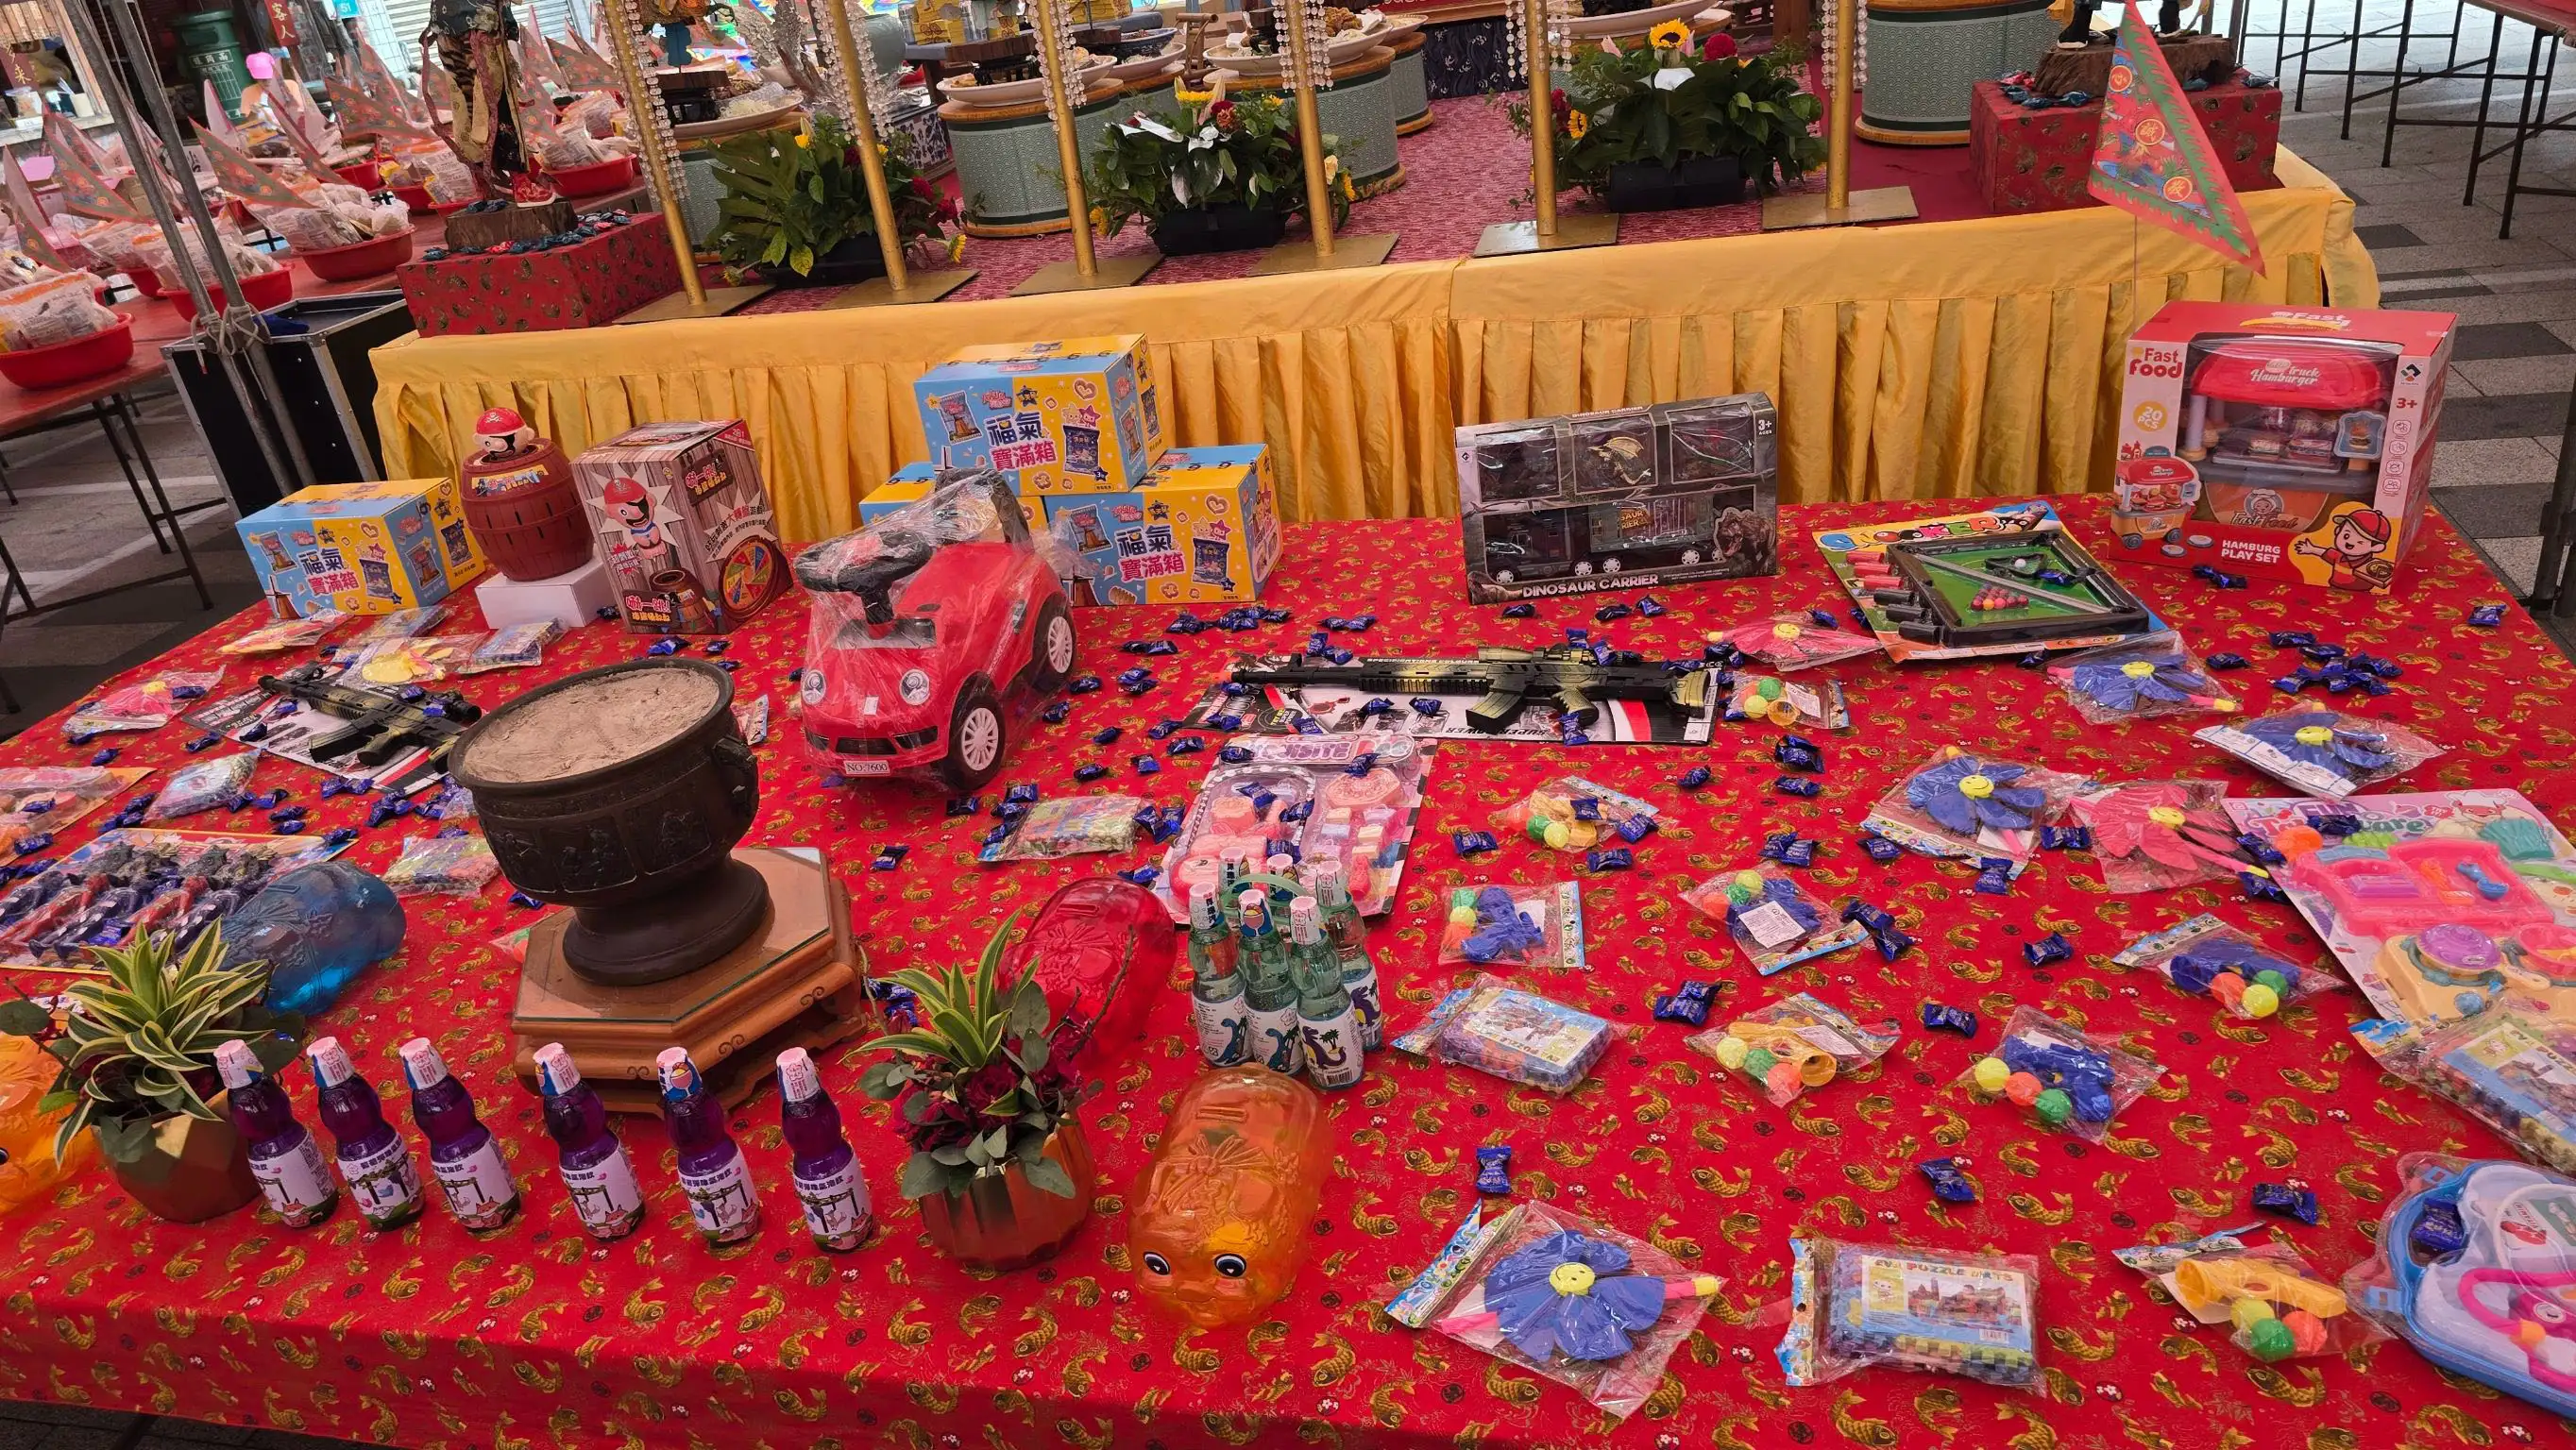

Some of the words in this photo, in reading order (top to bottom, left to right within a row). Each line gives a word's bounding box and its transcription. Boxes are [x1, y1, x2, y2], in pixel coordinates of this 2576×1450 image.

[2144, 347, 2178, 362] Fast
[2251, 369, 2319, 386] Hamburger
[2289, 365, 2321, 378] truck
[2397, 398, 2418, 409] 3+
[1572, 410, 1610, 418] DINOSAUR
[2143, 406, 2162, 421] 20
[987, 413, 1042, 446] 福氣
[1758, 419, 1771, 430] 3+
[2137, 415, 2159, 430] PCS
[991, 441, 1056, 470] 寶滿箱
[1117, 525, 1171, 557] 福氣
[2222, 540, 2280, 554] HAMBURG
[299, 548, 344, 575] 福氣
[2221, 548, 2254, 561] PLAY
[2255, 553, 2280, 564] SET
[1121, 552, 1185, 581] 寶滿箱
[309, 571, 359, 595] 寶滿箱
[1522, 580, 1597, 599] DINOSAUR
[1599, 574, 1659, 589] CARRIER
[1907, 1262, 1966, 1275] PUZZLE
